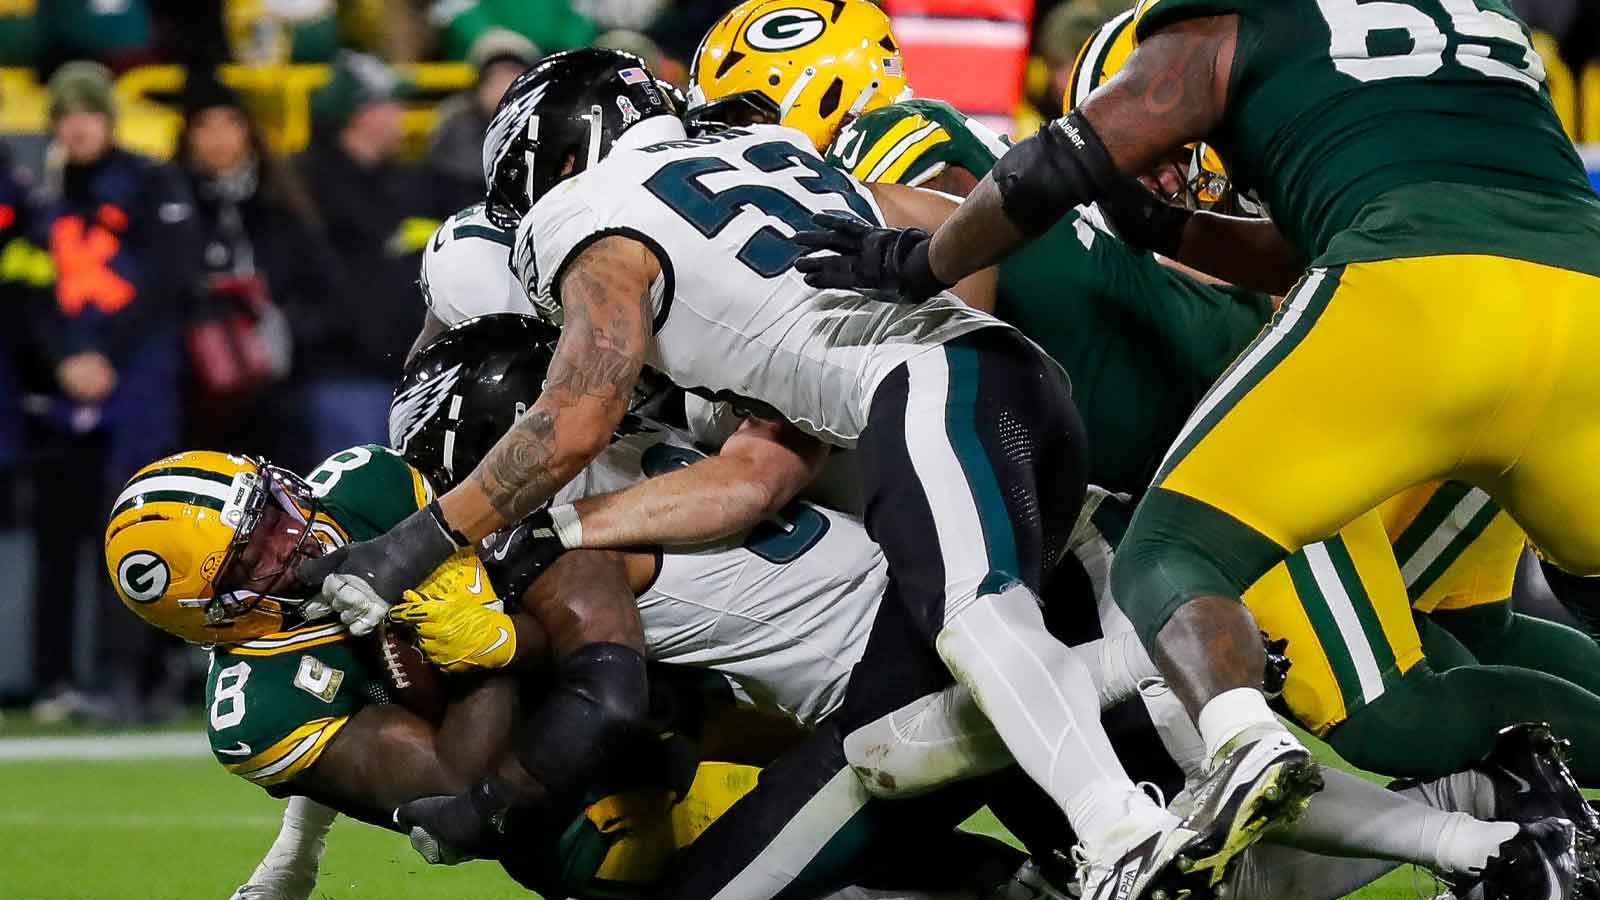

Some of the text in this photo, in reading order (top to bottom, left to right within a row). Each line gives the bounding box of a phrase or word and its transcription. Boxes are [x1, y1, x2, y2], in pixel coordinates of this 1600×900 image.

[1317, 0, 1546, 91] 65
[642, 141, 882, 279] 53
[210, 661, 252, 732] 8
